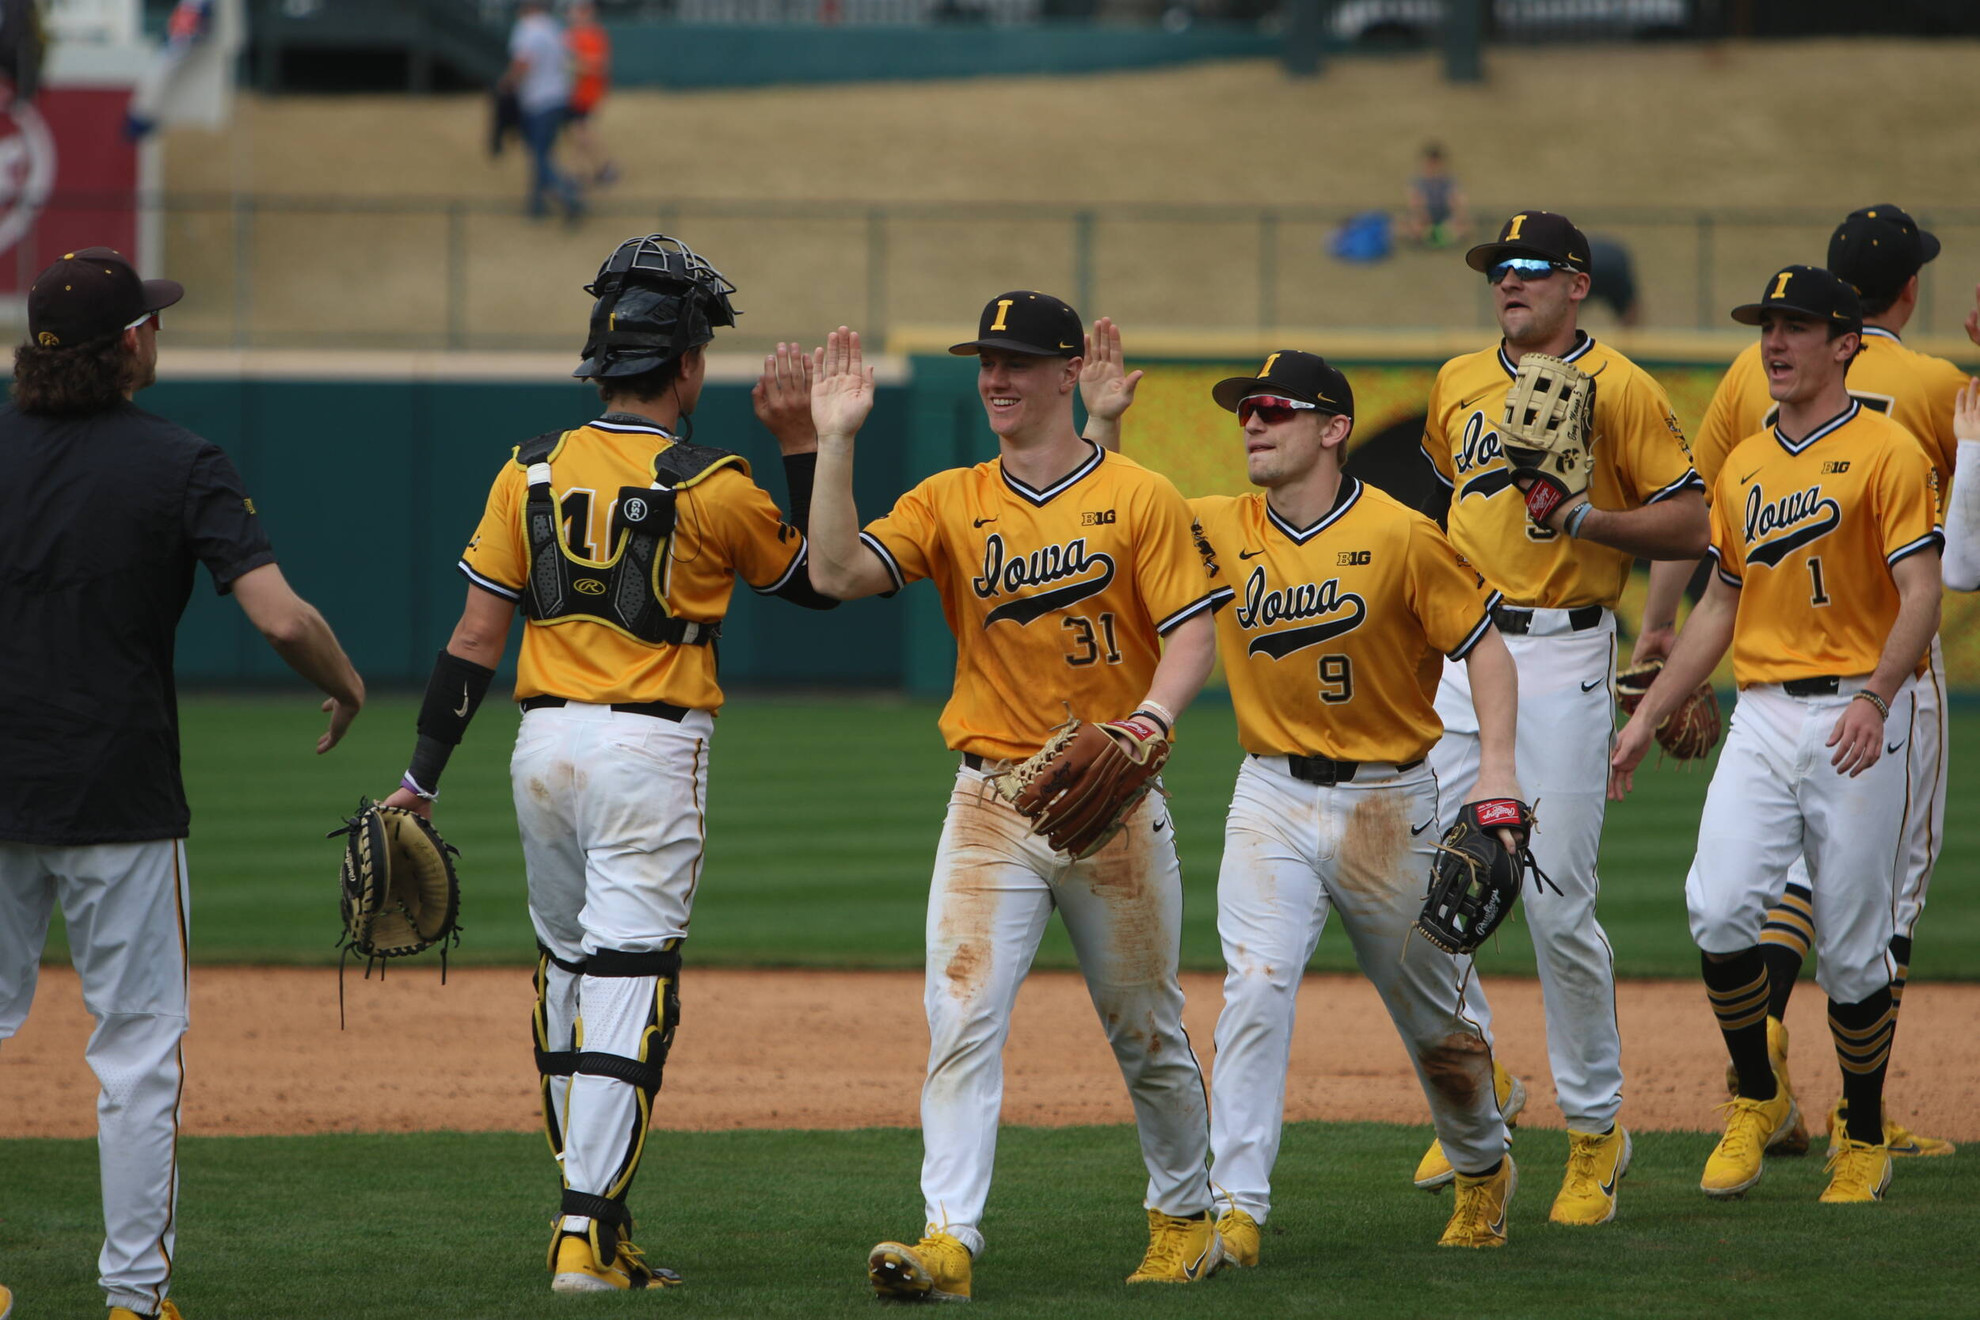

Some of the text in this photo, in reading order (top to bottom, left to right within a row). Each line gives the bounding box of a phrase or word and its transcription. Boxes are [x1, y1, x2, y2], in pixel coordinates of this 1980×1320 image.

[1504, 214, 1528, 242] I
[1770, 272, 1793, 299] I
[990, 299, 1014, 331] I
[1256, 353, 1281, 379] I
[1454, 409, 1504, 474] Io
[630, 500, 641, 519] GSC
[1742, 483, 1823, 547] Iowa
[972, 533, 1089, 600] Iowa
[1806, 555, 1831, 608] 1
[1236, 564, 1341, 631] Iowa
[1061, 612, 1123, 669] 31
[1317, 653, 1354, 706] 9
[1475, 887, 1501, 936] Rawlings
